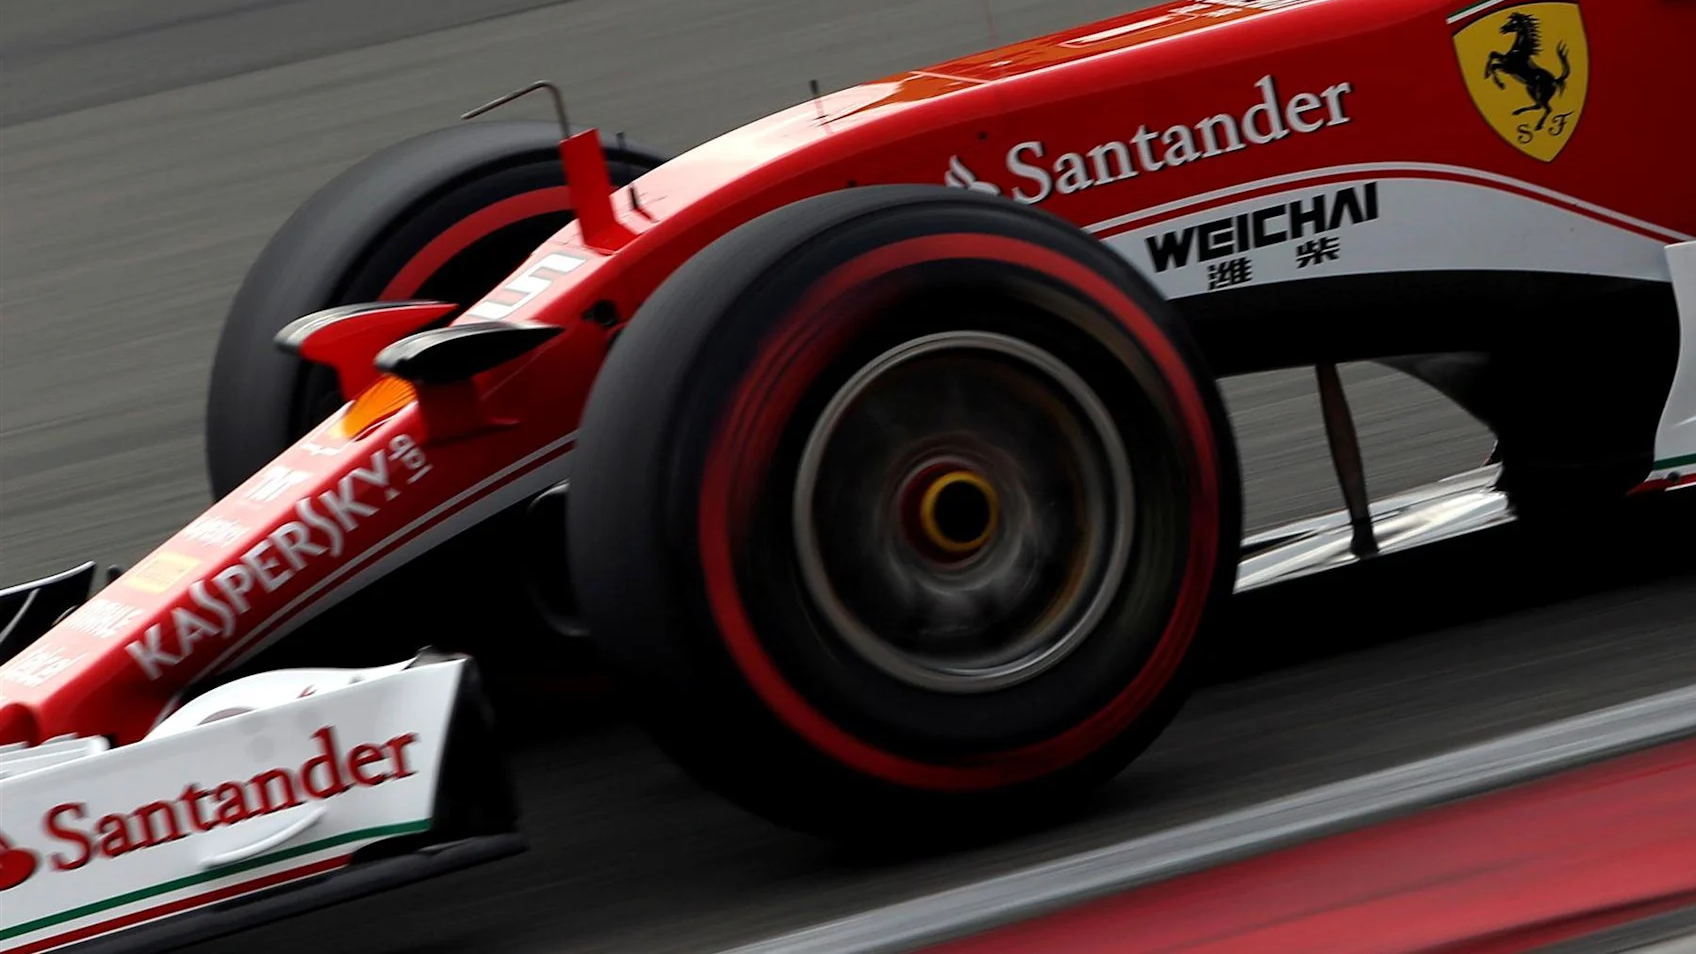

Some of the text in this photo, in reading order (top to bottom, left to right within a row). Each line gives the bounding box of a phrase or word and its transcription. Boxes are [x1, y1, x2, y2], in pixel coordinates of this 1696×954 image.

[1005, 73, 1352, 206] Santander
[1145, 181, 1380, 274] WEICHAI
[123, 448, 392, 682] KASPERSKY
[43, 725, 421, 873] Santander
